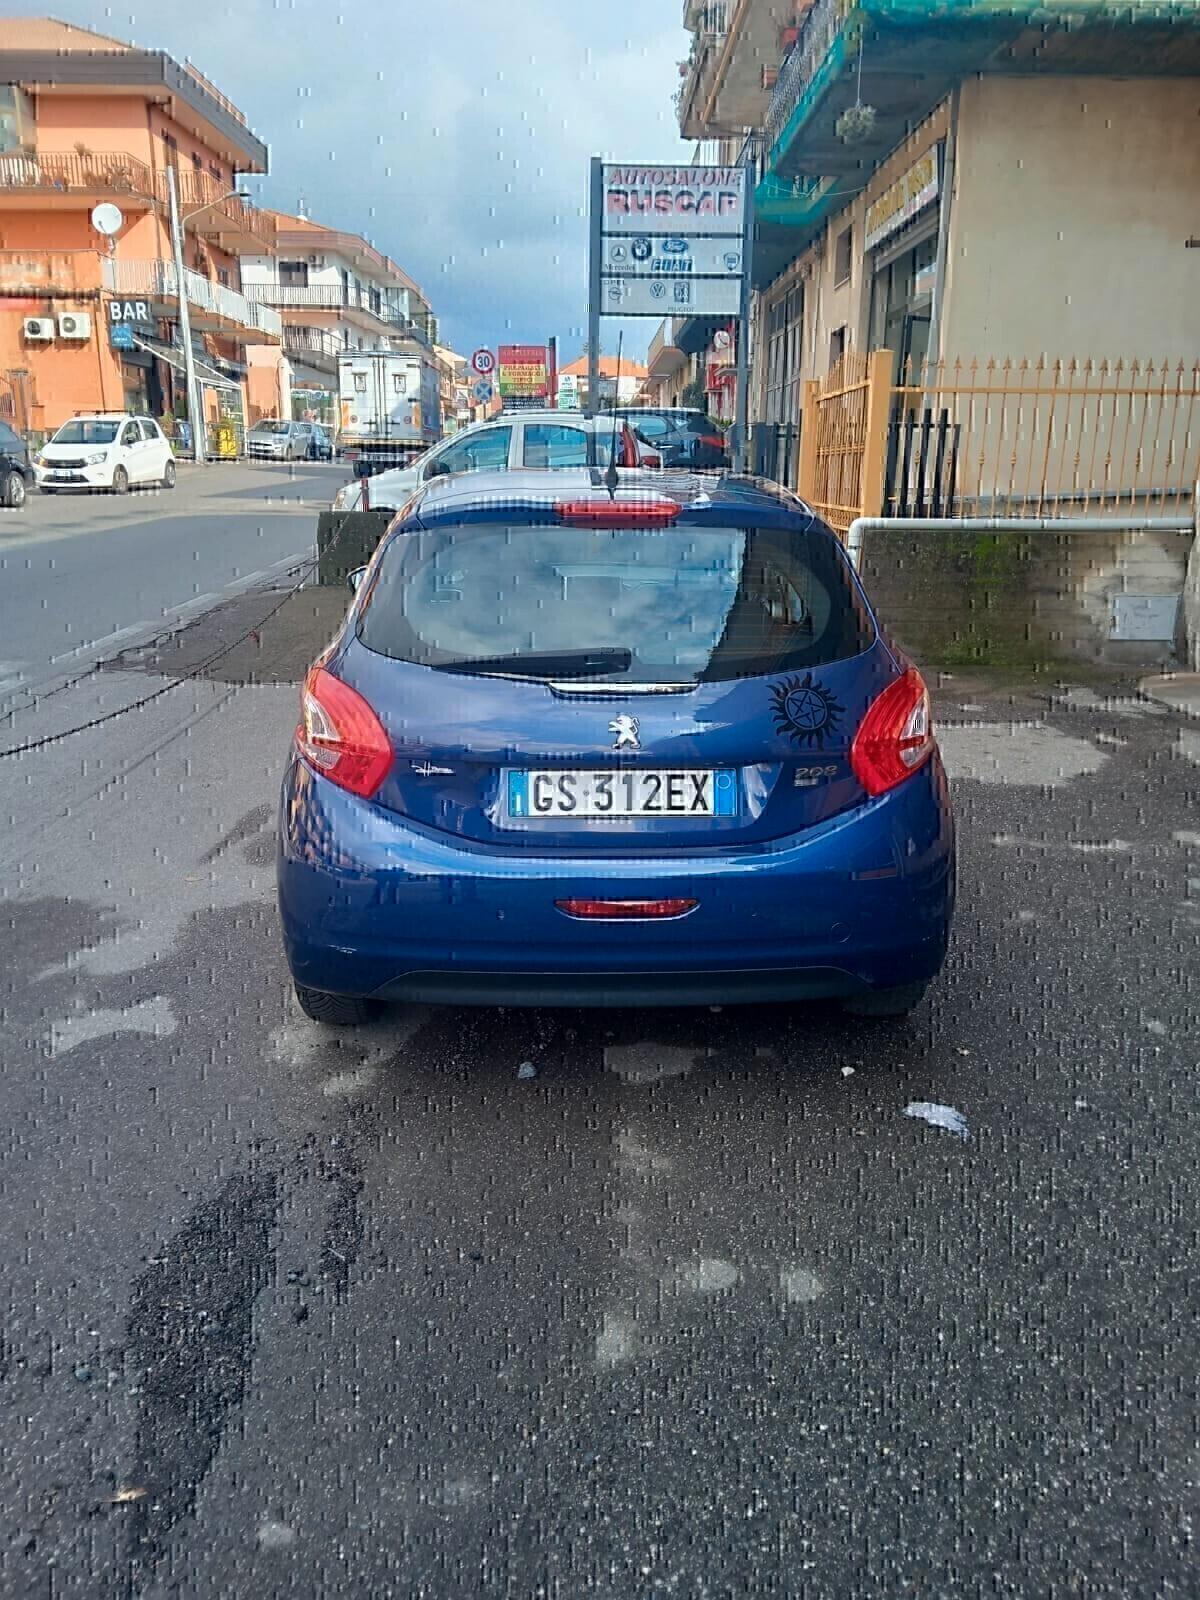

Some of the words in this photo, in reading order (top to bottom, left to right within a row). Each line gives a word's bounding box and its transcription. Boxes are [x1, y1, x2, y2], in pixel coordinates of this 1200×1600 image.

[652, 259, 692, 272] FIAT
[110, 301, 148, 320] BAR
[477, 355, 490, 368] 30
[533, 774, 577, 812] GS
[594, 774, 709, 812] 312EX
